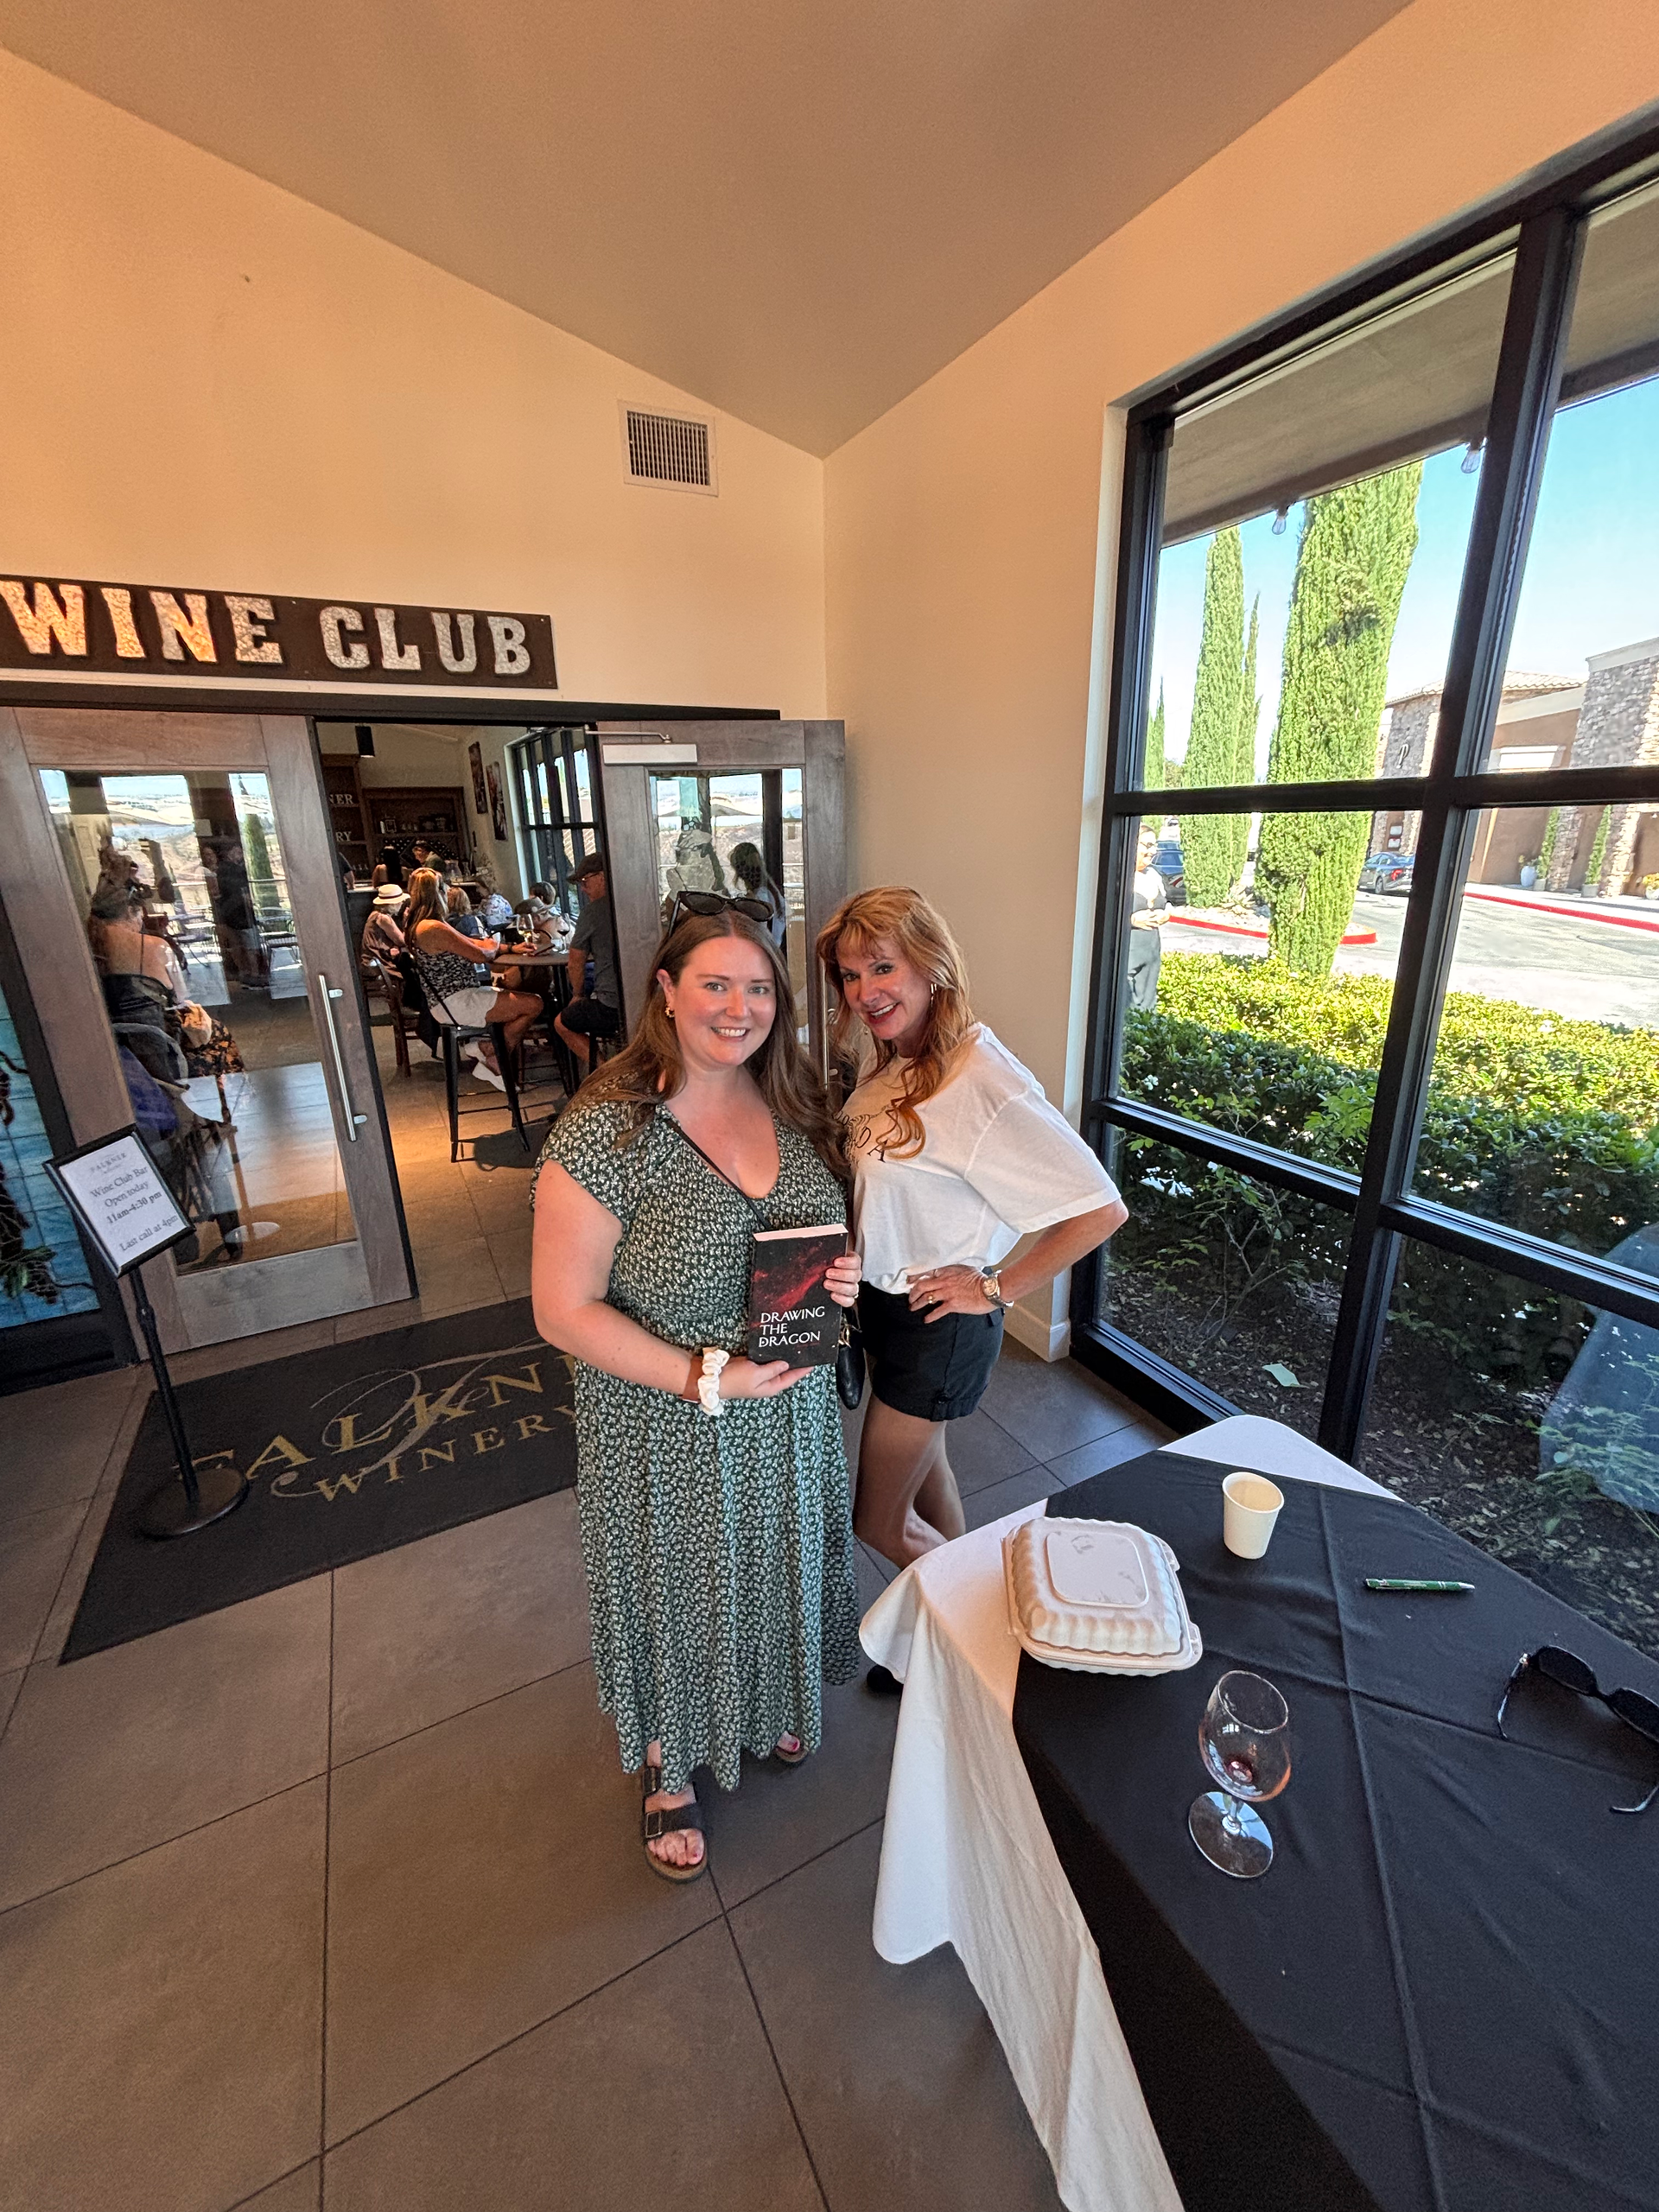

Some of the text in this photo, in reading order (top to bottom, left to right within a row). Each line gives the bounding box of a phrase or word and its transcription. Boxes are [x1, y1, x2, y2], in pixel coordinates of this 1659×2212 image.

[0, 580, 531, 675] WINE CLUB
[90, 1184, 114, 1198] Wine
[114, 1173, 133, 1186] Club
[133, 1166, 148, 1177] Bar
[105, 1181, 149, 1207] Open today
[149, 1192, 162, 1204] pm
[119, 1215, 179, 1251] Last call at 4pm
[760, 1306, 825, 1324] DRAWING
[759, 1331, 821, 1348] DRAGON
[760, 1323, 788, 1336] THE
